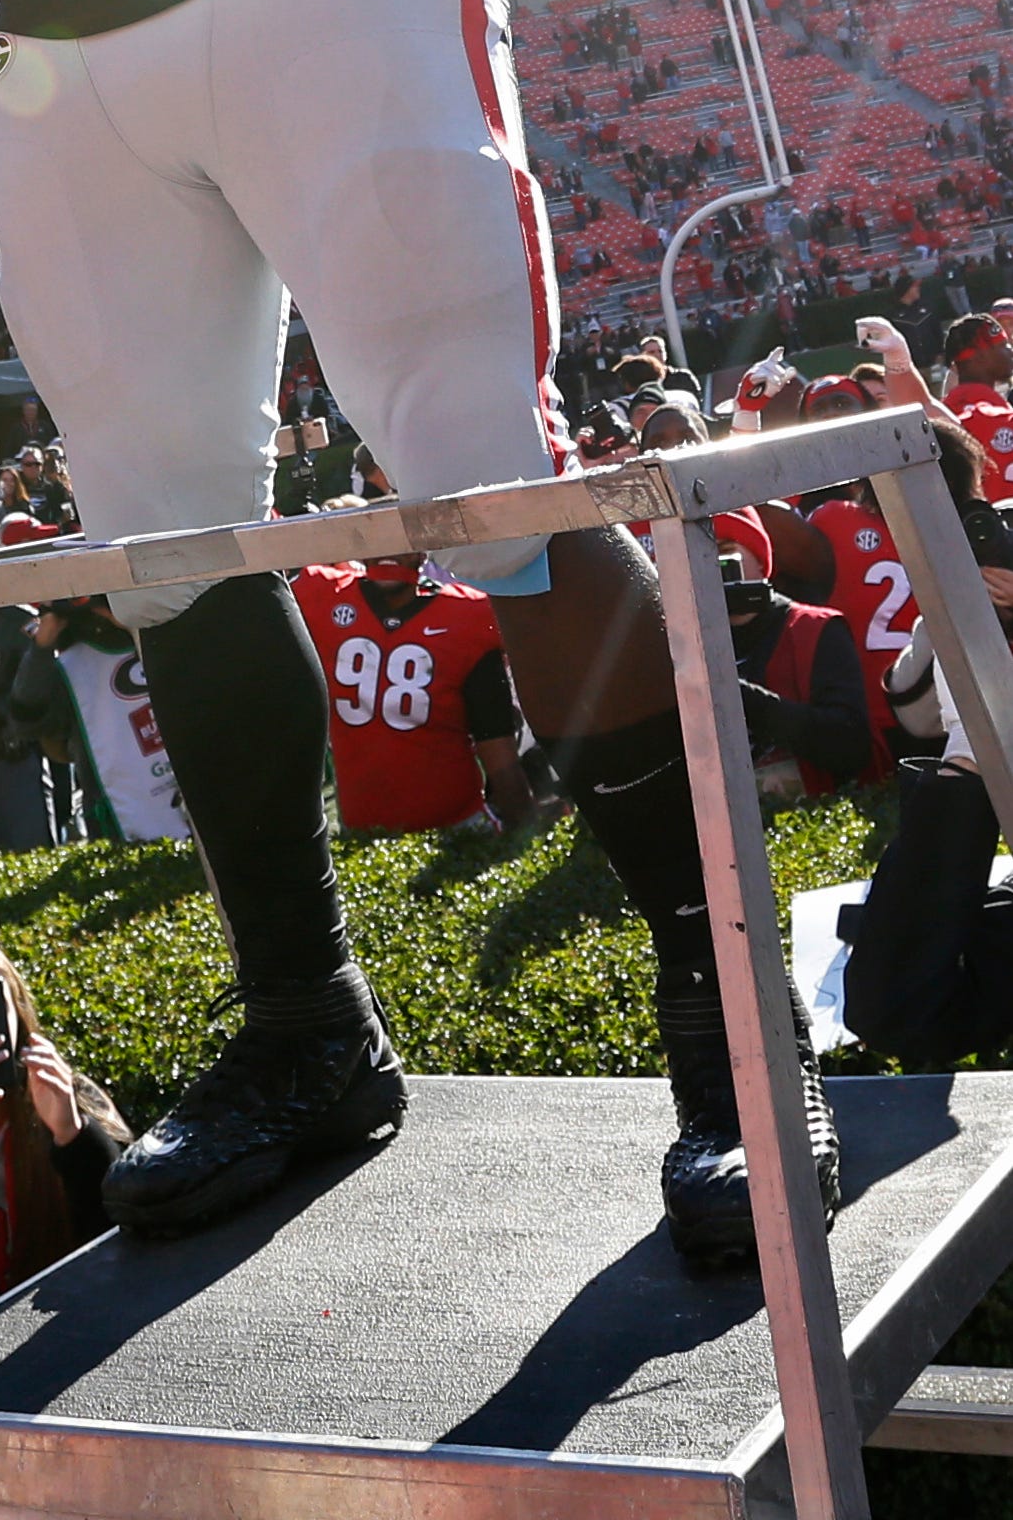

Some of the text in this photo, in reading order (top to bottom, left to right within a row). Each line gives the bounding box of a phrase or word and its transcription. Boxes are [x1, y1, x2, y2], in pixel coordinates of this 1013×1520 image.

[856, 530, 879, 551] SEC
[334, 604, 356, 626] SEC
[334, 635, 434, 732] 98
